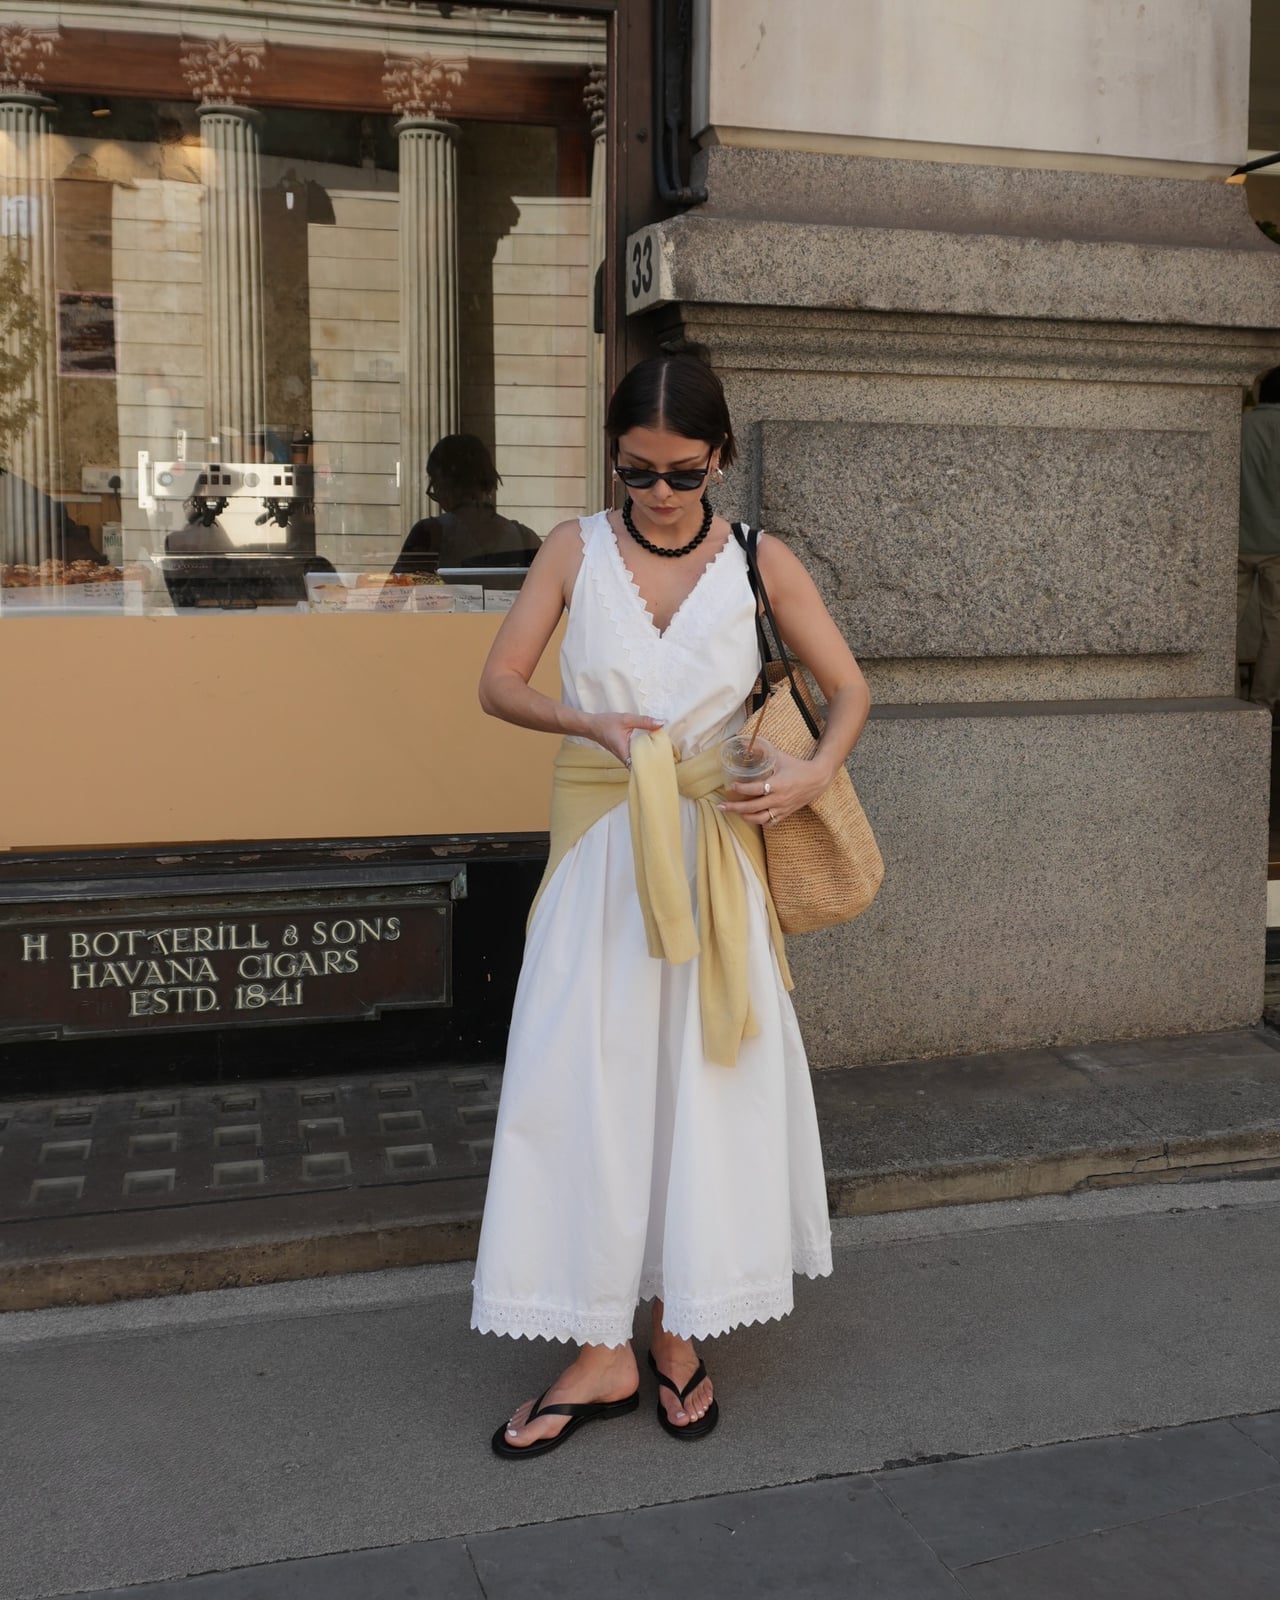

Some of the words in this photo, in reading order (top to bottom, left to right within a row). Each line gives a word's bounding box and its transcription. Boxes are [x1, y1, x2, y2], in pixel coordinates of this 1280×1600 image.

[632, 235, 653, 298] 33
[282, 924, 298, 946] &
[312, 917, 400, 945] SONS
[71, 956, 219, 989] HAVANA
[237, 949, 359, 979] CIGARS
[128, 986, 220, 1017] ESTD.
[234, 979, 303, 1009] 1841
